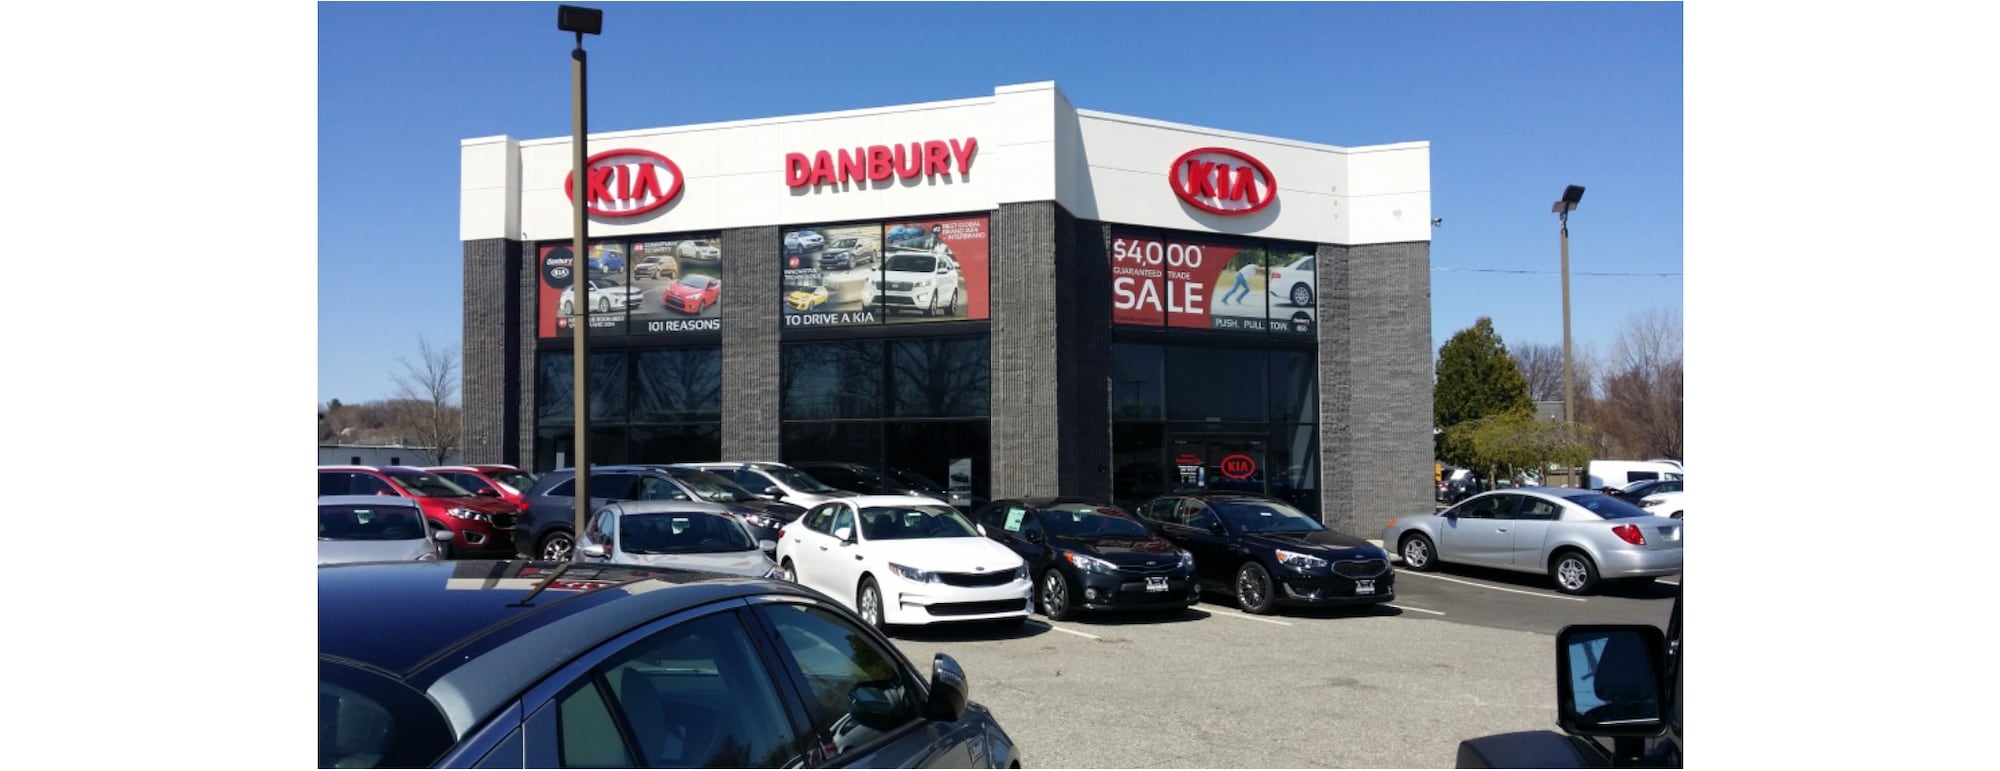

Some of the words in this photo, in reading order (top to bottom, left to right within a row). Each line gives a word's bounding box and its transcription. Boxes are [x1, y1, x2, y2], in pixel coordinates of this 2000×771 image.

[785, 137, 978, 187] DANBURY
[587, 162, 663, 203] KIA
[1187, 159, 1260, 204] KIA
[1113, 266, 1162, 278] GUARANTEED
[1168, 271, 1191, 280] TRADE
[1113, 277, 1204, 315] SALE
[647, 321, 664, 332] 101
[665, 319, 720, 332] REASONS
[784, 314, 801, 326] TO
[803, 312, 839, 325] DRIVE
[841, 312, 850, 323] A
[852, 311, 874, 323] KIA
[1215, 318, 1239, 328] PUSH.
[1227, 461, 1249, 473] KIA
